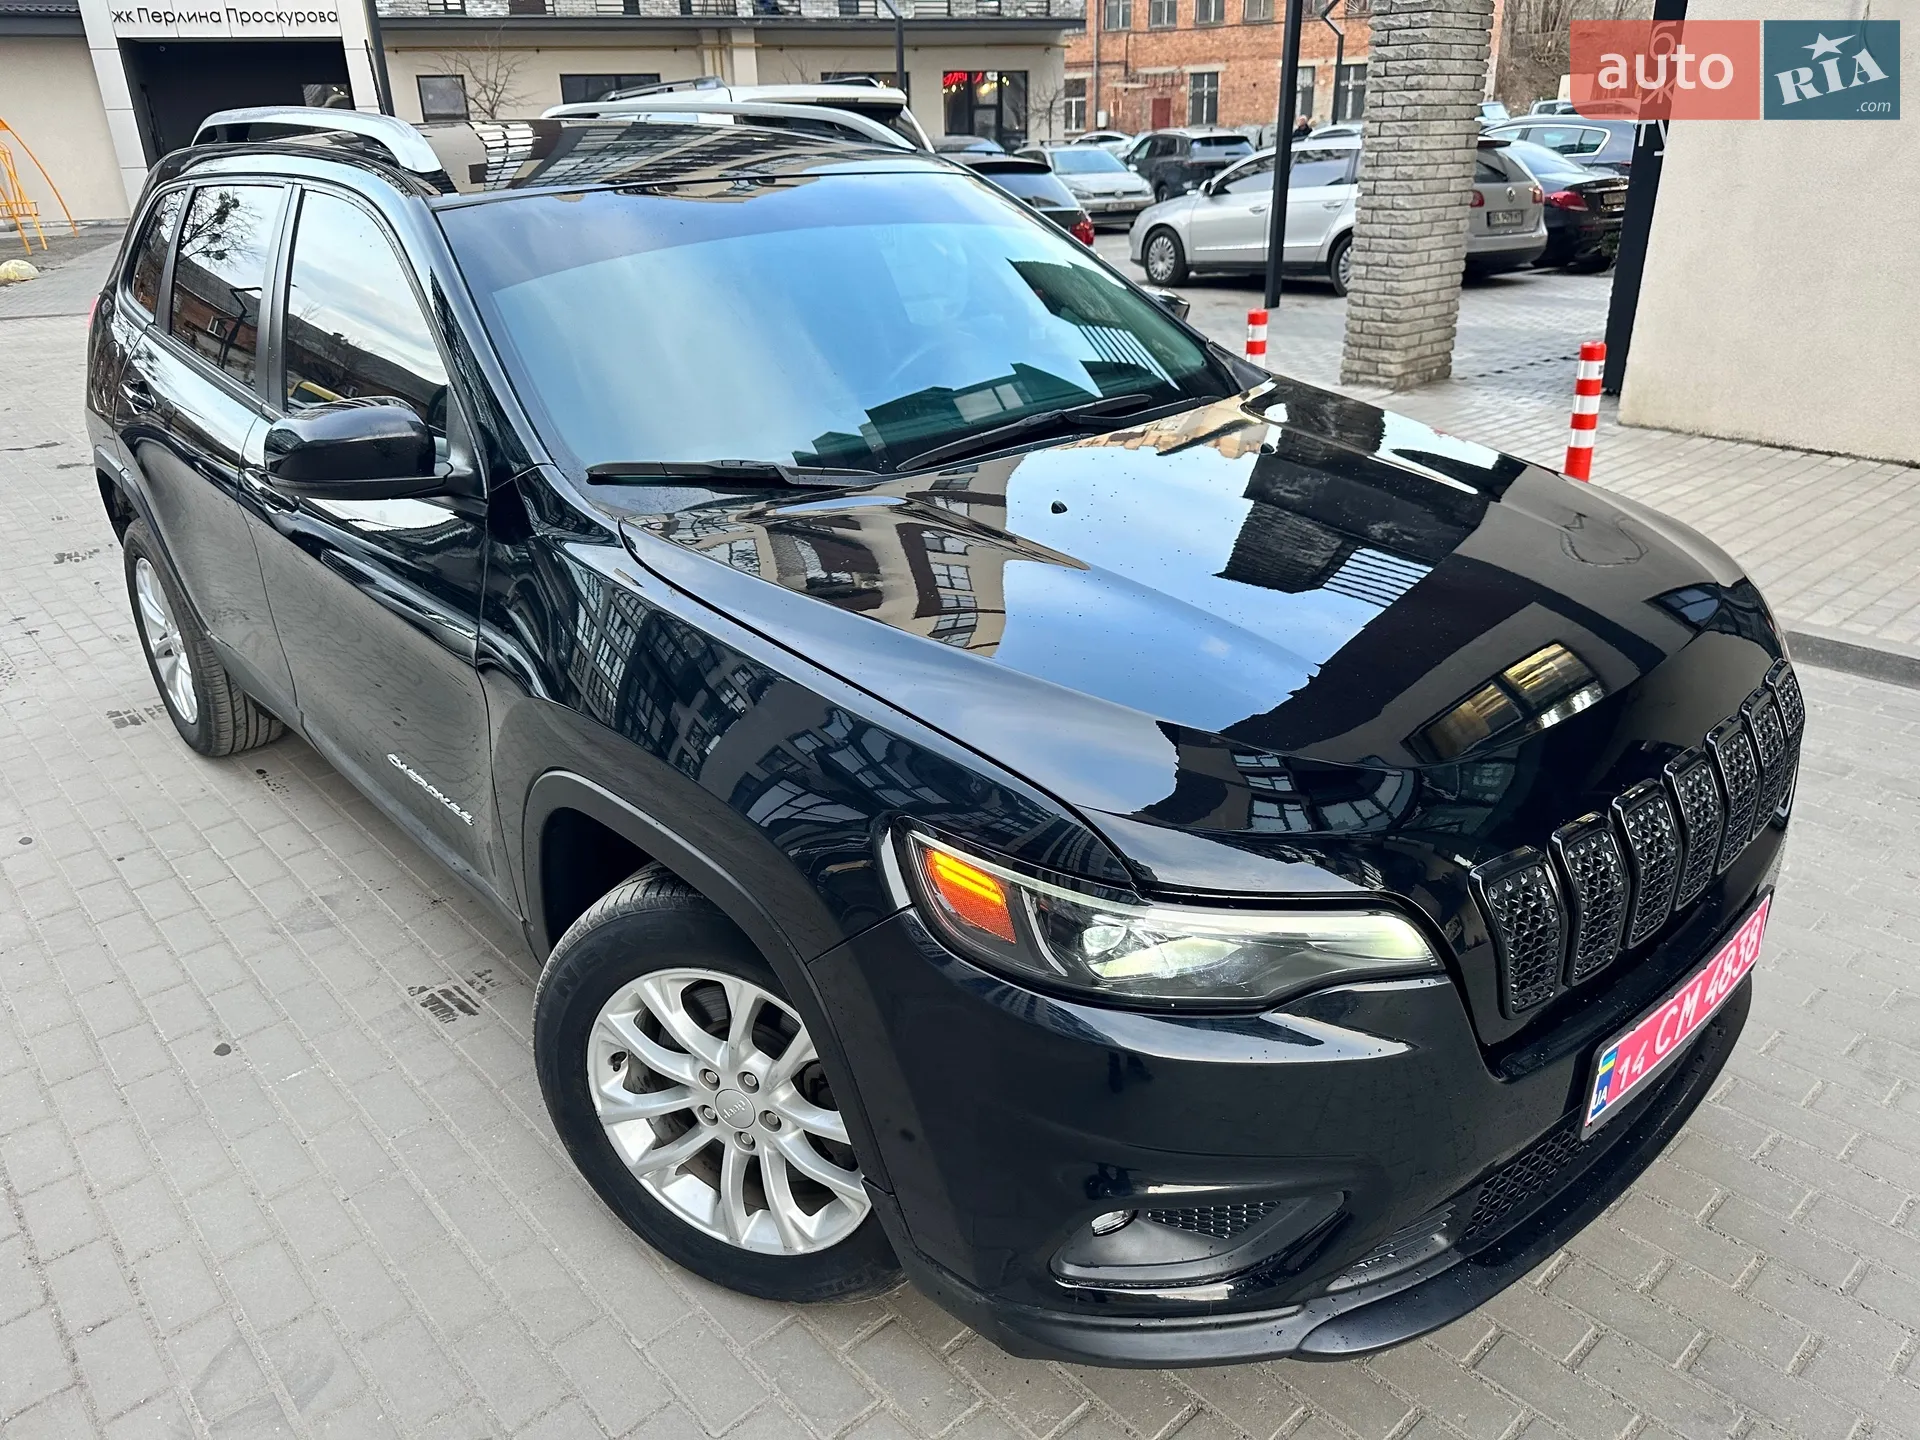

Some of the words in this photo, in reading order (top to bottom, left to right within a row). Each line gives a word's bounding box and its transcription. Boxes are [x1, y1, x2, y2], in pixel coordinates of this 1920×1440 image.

[137, 8, 222, 26] Перлина
[226, 8, 339, 26] Проскурова
[1617, 1039, 1649, 1092] 14
[1654, 981, 1703, 1055] CM
[1703, 915, 1762, 1006] 4838
[1592, 1088, 1608, 1110] UA
